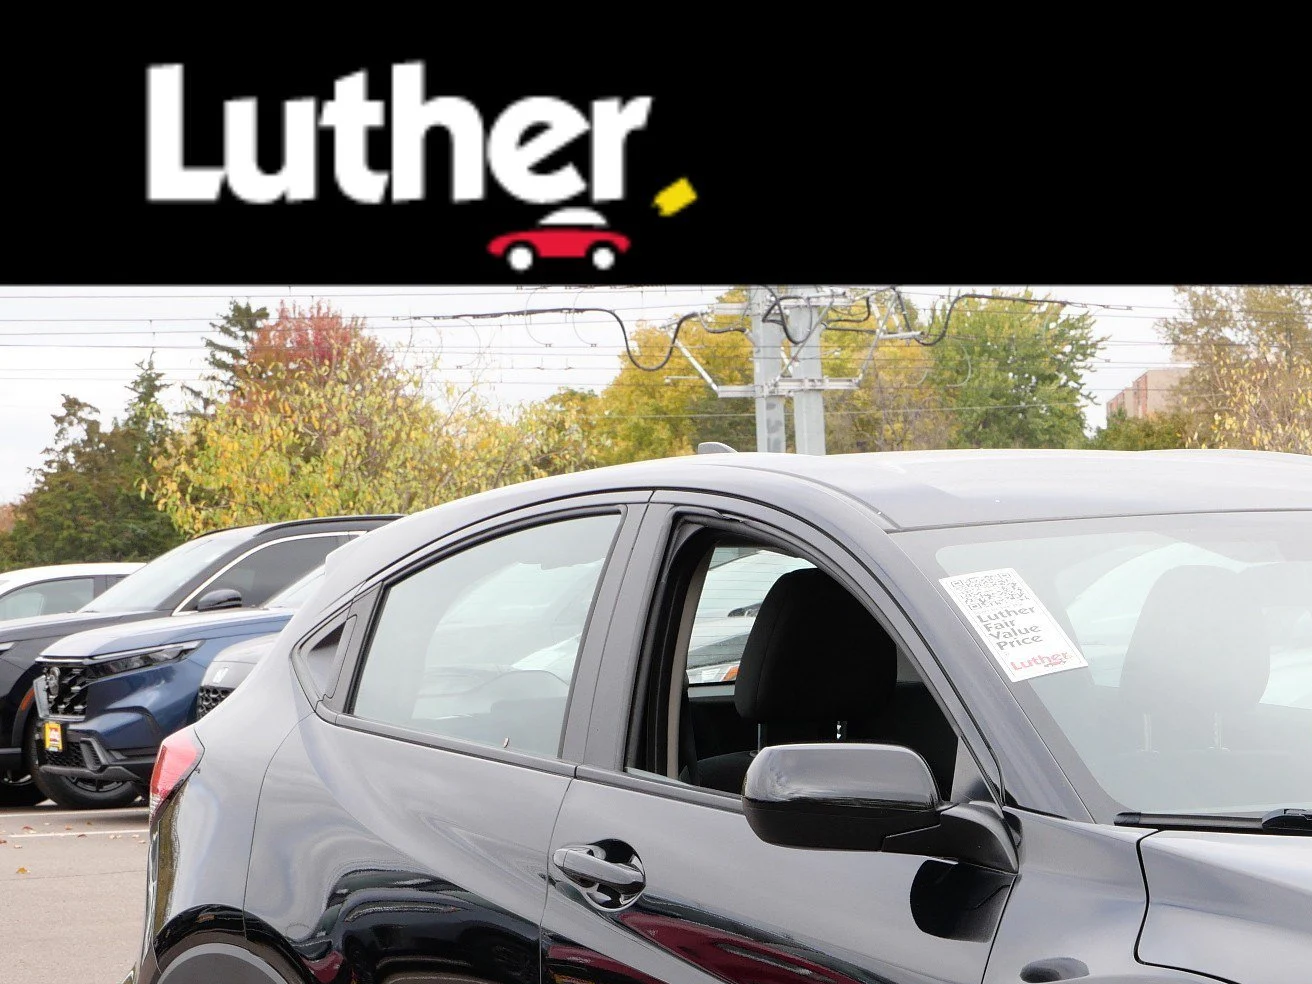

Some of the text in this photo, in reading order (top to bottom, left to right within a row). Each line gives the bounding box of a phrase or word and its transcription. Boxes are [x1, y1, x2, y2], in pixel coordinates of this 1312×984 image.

[976, 606, 1036, 623] Luther
[982, 619, 1016, 633] Fair
[989, 624, 1041, 640] Value
[996, 634, 1043, 651] Price
[1010, 651, 1069, 671] Luther
